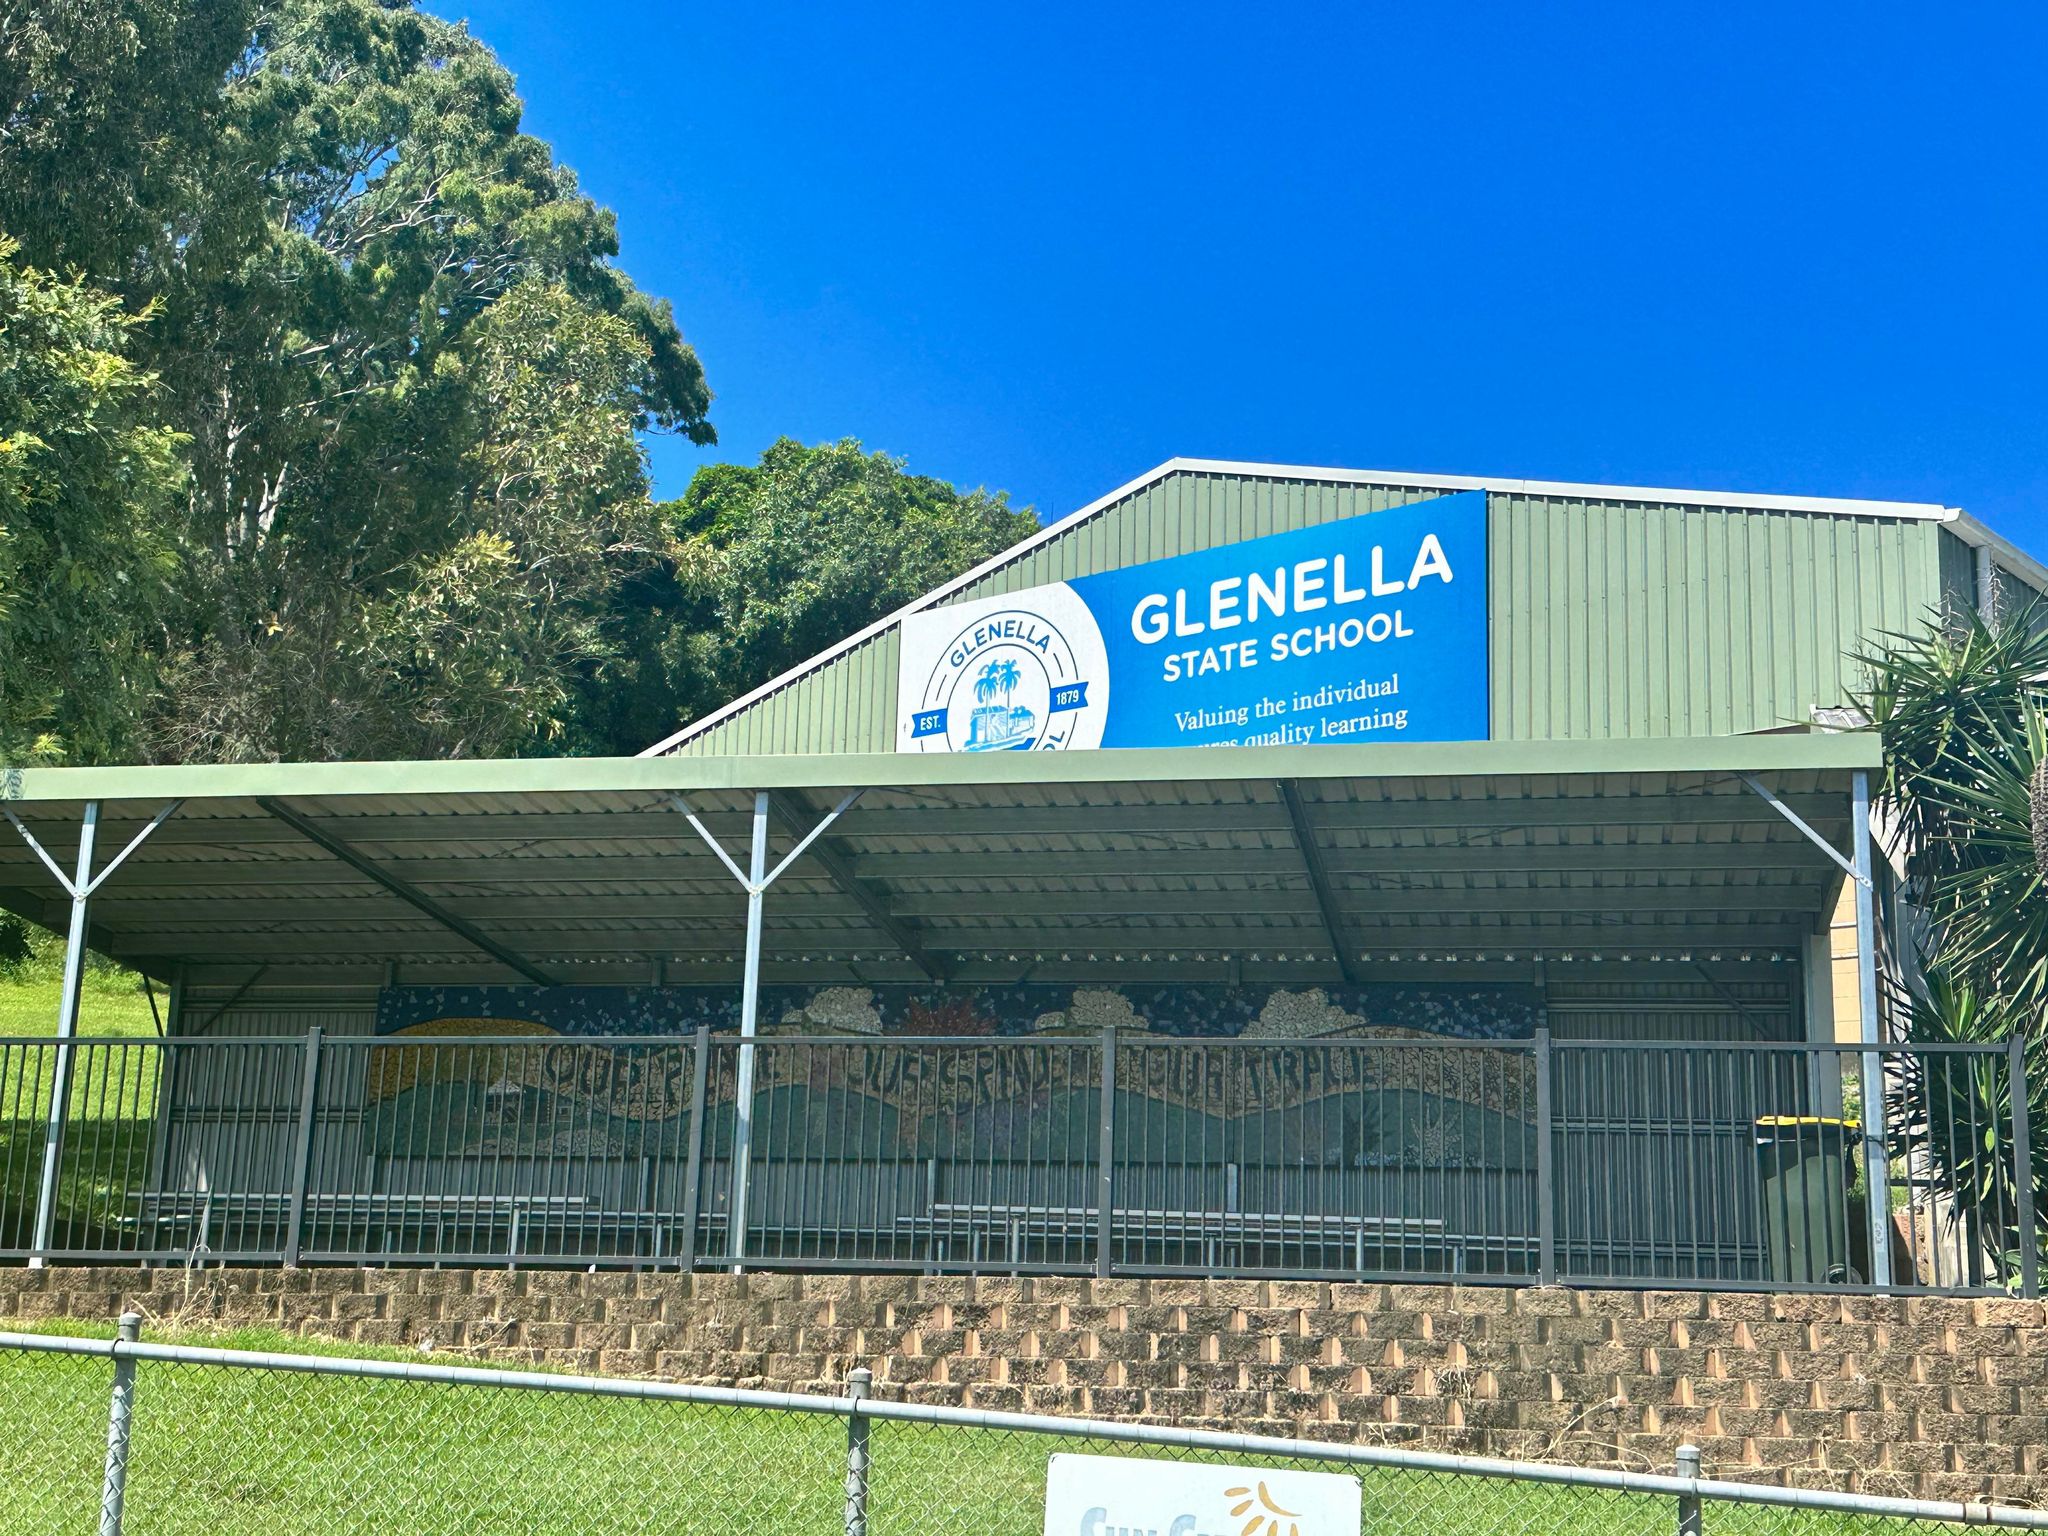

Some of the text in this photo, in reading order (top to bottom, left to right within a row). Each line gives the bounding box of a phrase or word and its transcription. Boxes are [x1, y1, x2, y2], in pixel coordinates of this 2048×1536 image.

[1131, 533, 1453, 645] GLENELLA
[950, 619, 1050, 667] GLENELLA
[1163, 609, 1415, 682] STATE SCHOOL
[1055, 689, 1079, 706] 1879
[1174, 673, 1399, 732] Valuing the individual
[919, 715, 941, 731] EST.
[1320, 708, 1408, 738] learning
